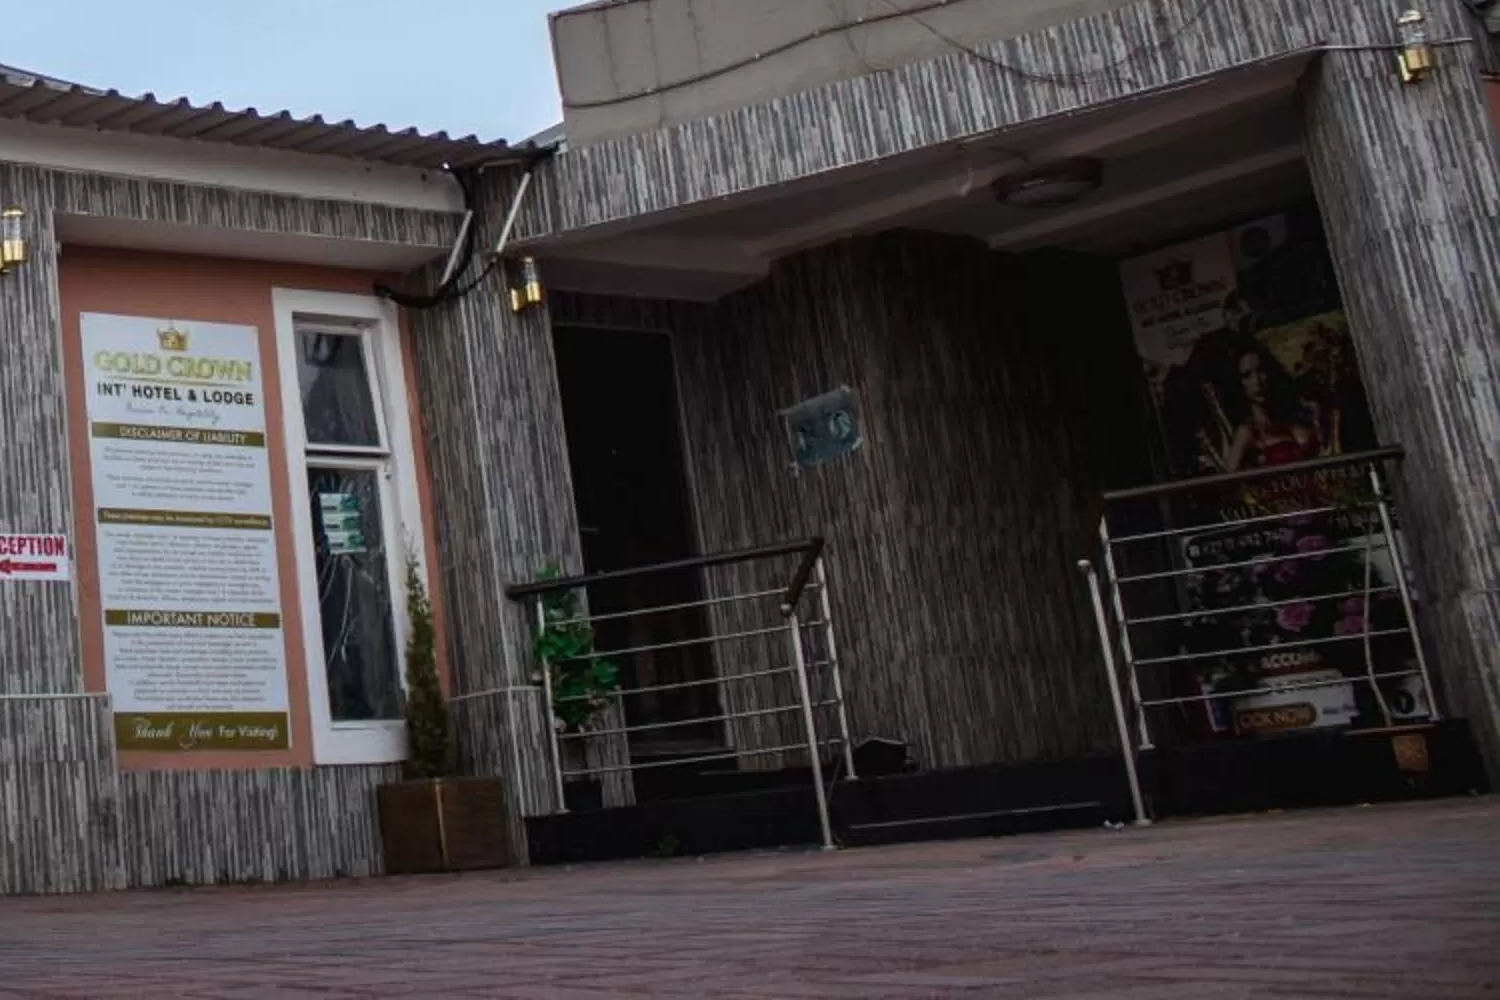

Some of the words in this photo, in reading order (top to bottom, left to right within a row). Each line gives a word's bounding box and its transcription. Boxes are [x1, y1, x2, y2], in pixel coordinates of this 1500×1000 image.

[93, 350, 161, 374] GOLD
[166, 355, 253, 381] CROWN
[131, 384, 182, 401] HOTEL
[187, 388, 197, 401] &
[203, 389, 255, 406] LODGE
[119, 426, 182, 442] DISCLAIMER
[126, 611, 204, 626] IMPORTANT
[206, 612, 257, 627] NOTICE
